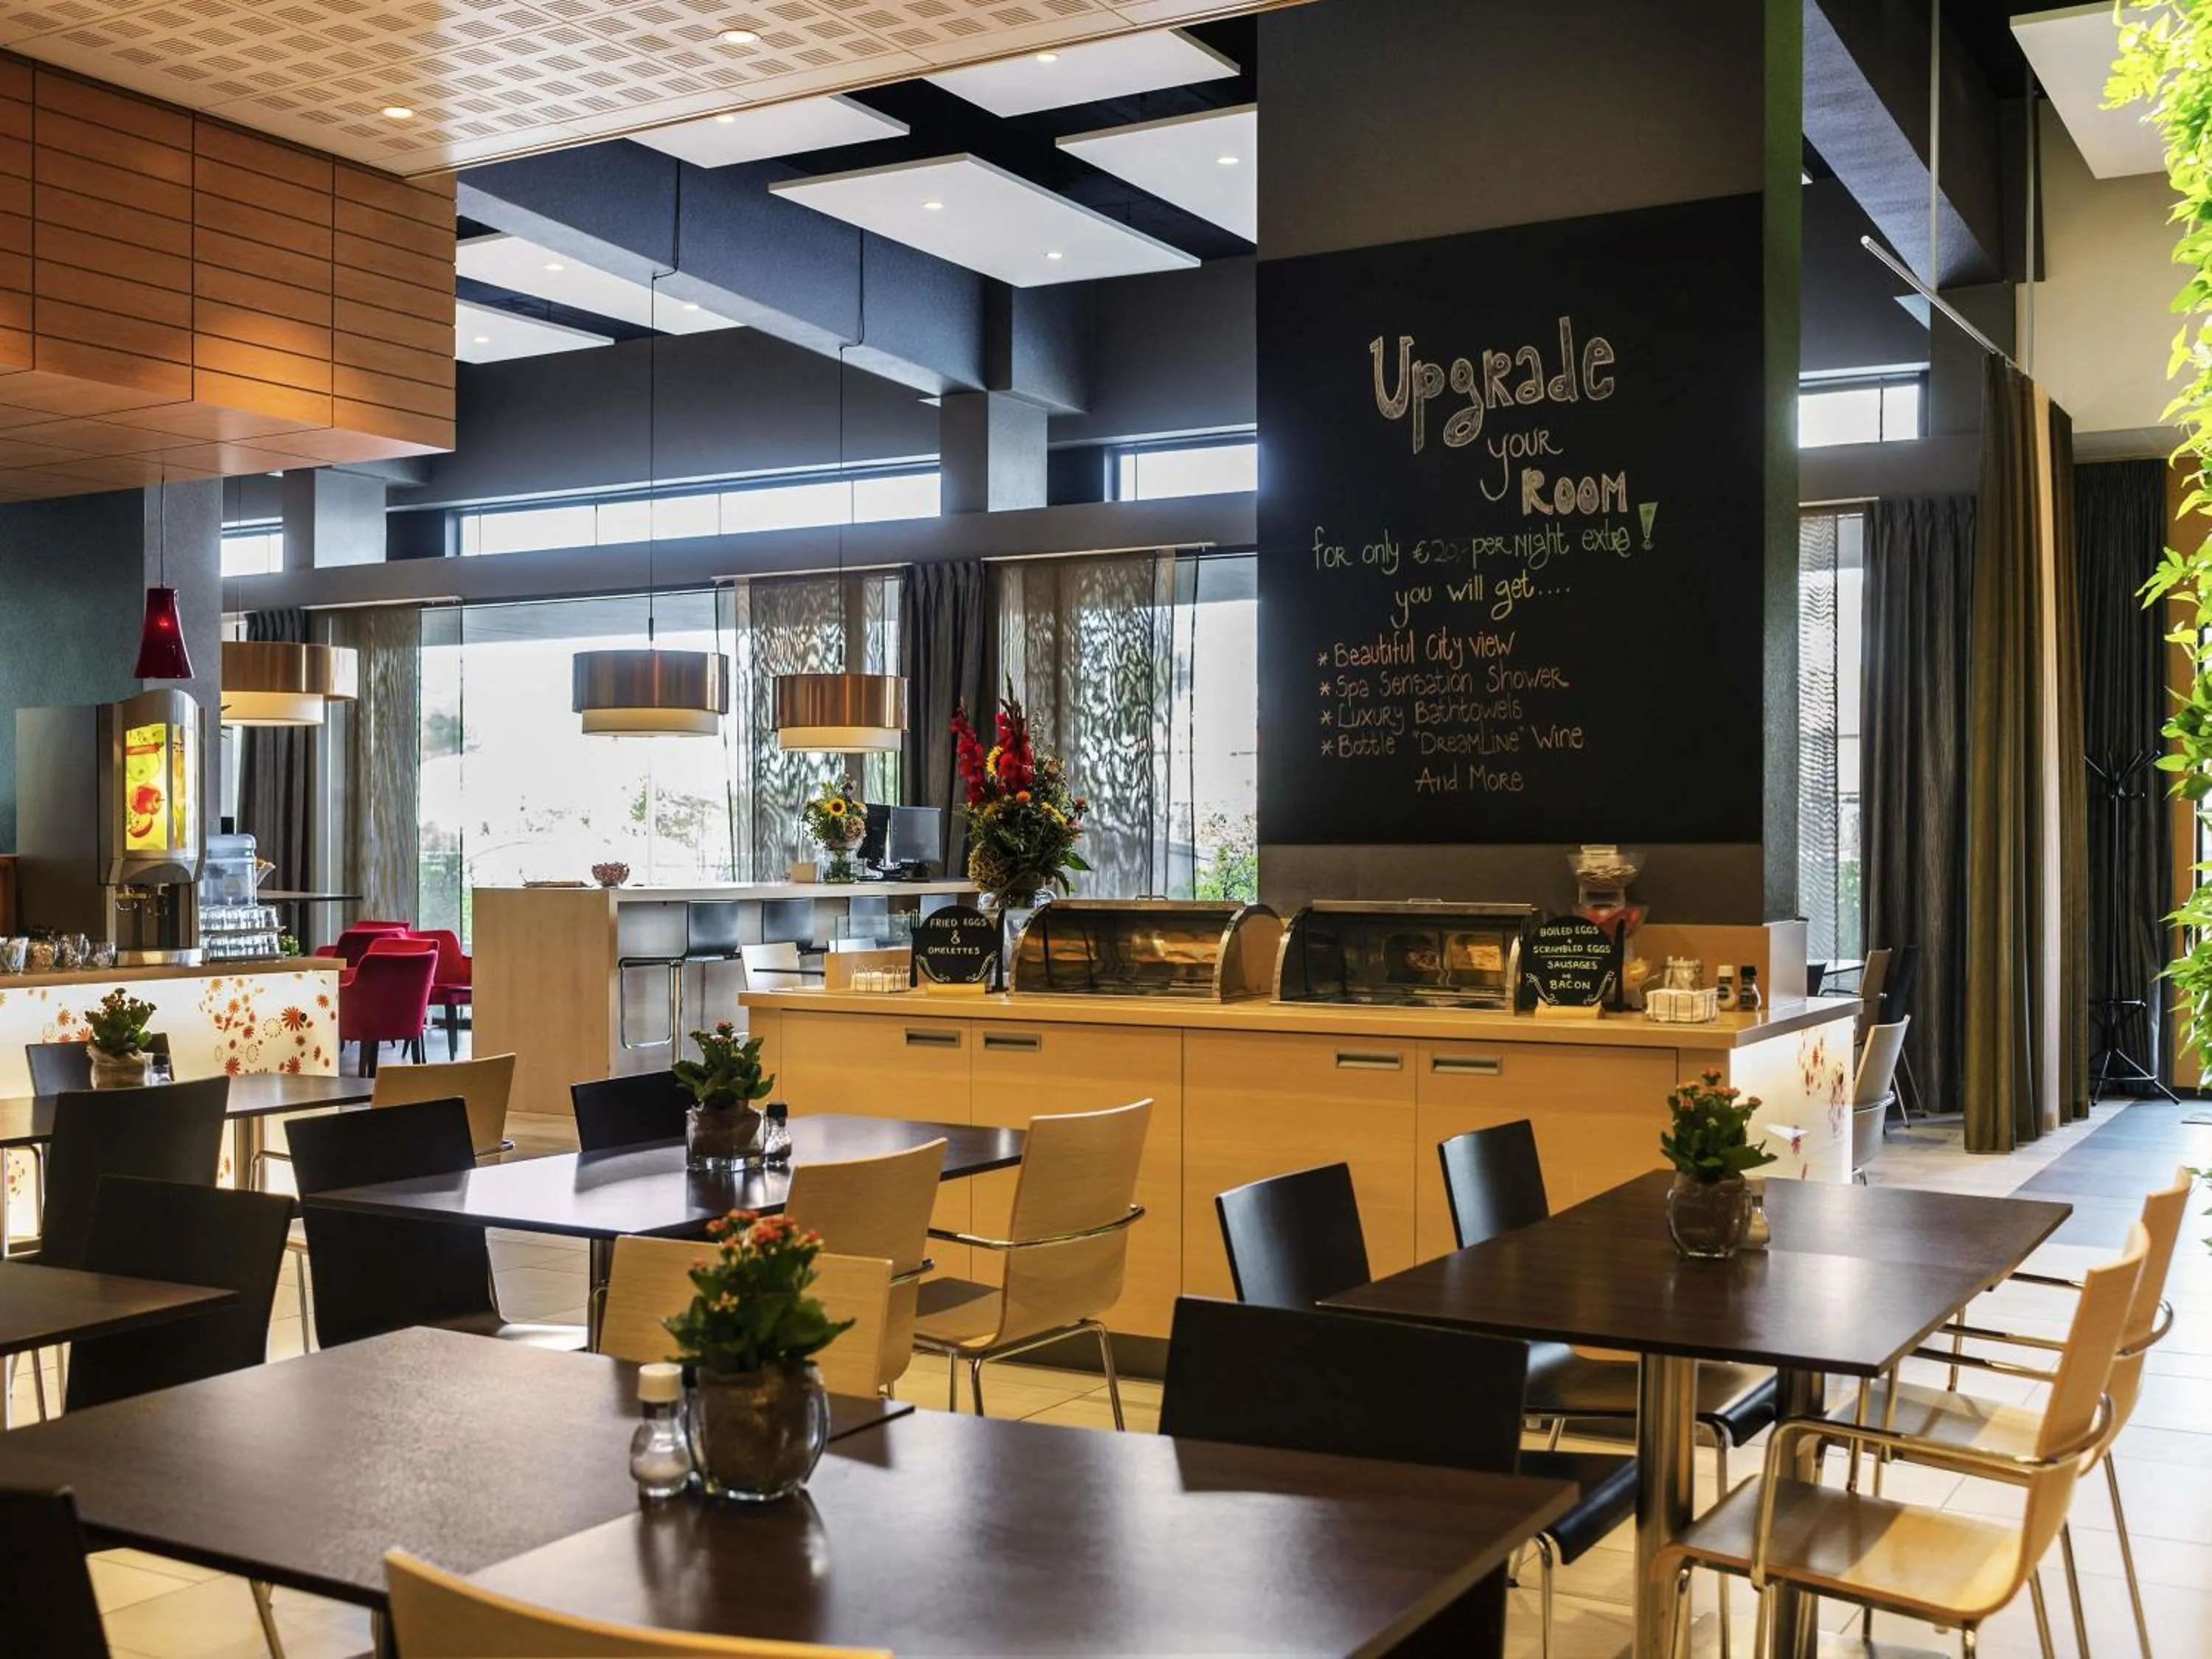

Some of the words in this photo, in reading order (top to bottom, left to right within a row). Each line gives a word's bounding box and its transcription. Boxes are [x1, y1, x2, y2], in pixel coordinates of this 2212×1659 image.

[1369, 316, 1615, 455] Upgrade
[1521, 467, 1628, 516] ROOM
[1362, 528, 1399, 575] only
[1390, 585, 1433, 629] you
[1446, 574, 1483, 602] will
[1334, 629, 1414, 667] Beautiful
[1426, 625, 1464, 670] City
[1335, 675, 1370, 708] Spa
[1380, 668, 1472, 697] Sensation
[1486, 659, 1570, 693] Shower
[1338, 731, 1396, 758] Bottle
[1531, 724, 1585, 749] Wine
[1415, 762, 1458, 793] And
[930, 917, 958, 928] FRIED
[963, 917, 987, 928] EGGS
[950, 930, 961, 945] &
[1540, 927, 1573, 937] BOILED
[1574, 925, 1599, 935] EGGS
[927, 946, 980, 956] OMELETTES
[1533, 945, 1584, 954] SCRAMBLED
[1586, 945, 1611, 954] EGGS
[1547, 961, 1598, 970] SAUSAGES
[1549, 980, 1590, 990] BACON
